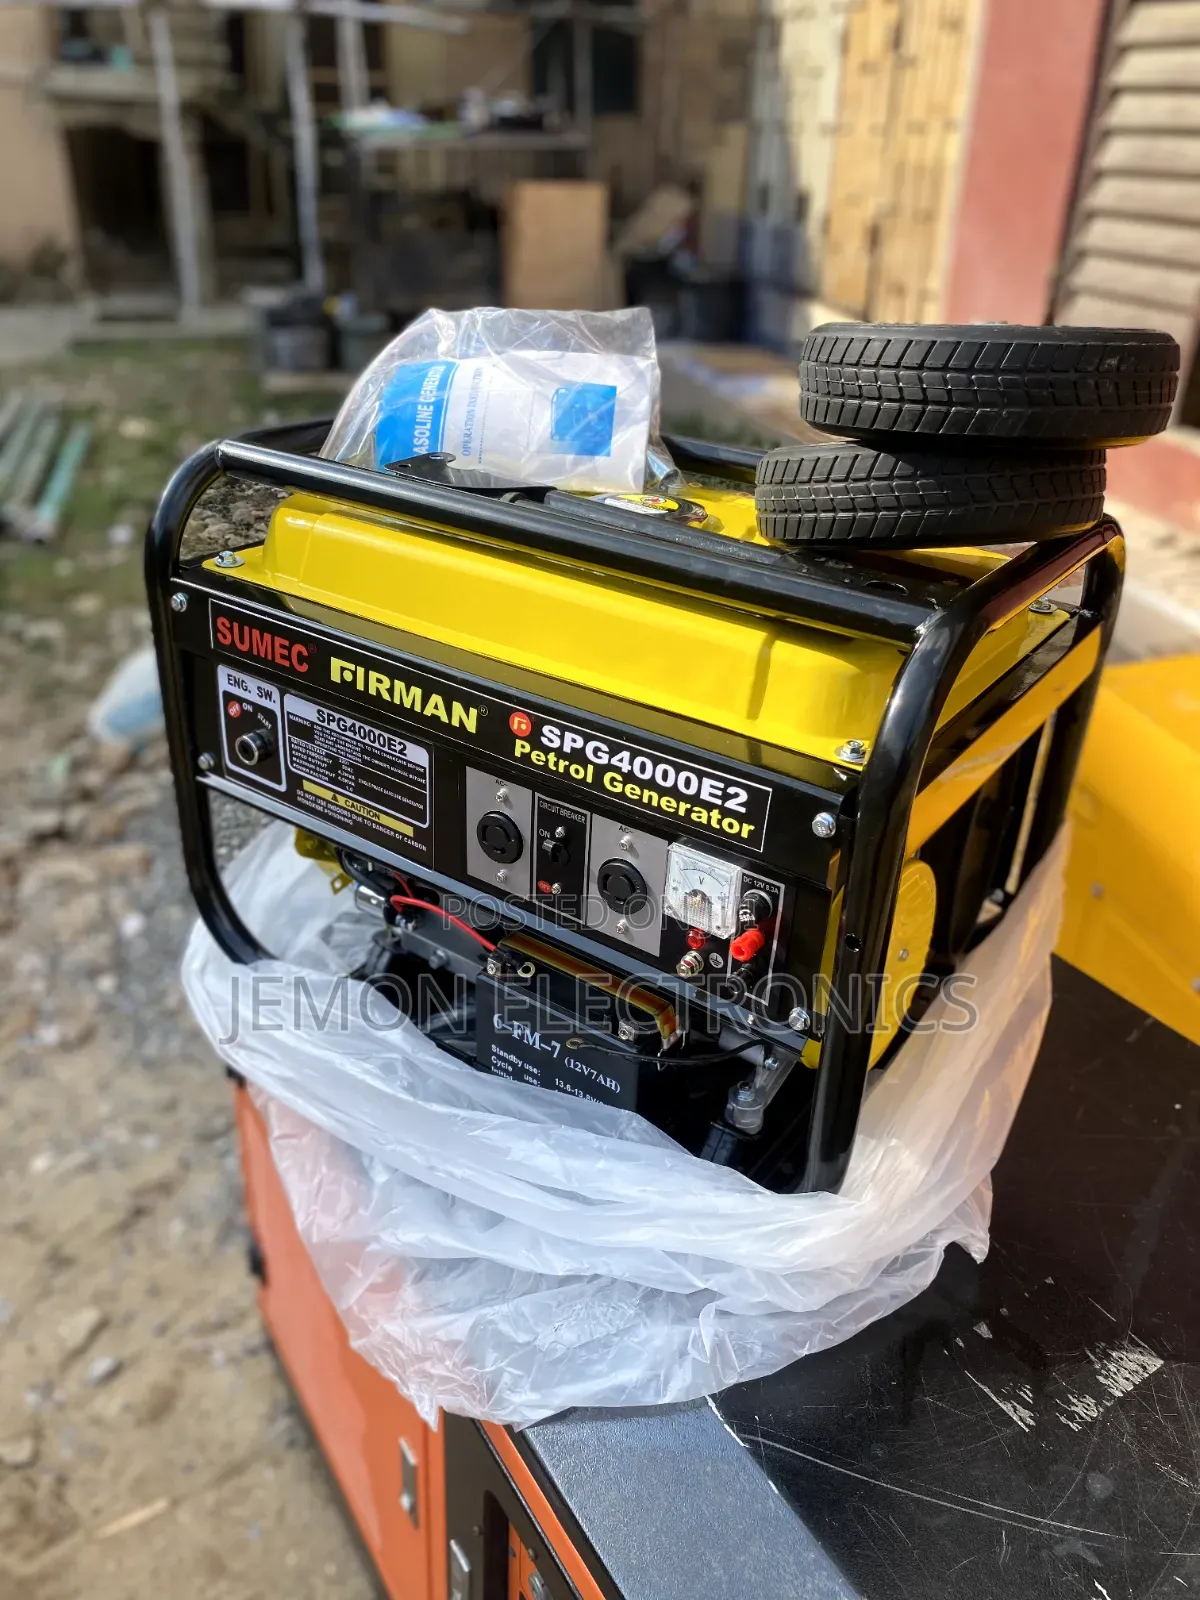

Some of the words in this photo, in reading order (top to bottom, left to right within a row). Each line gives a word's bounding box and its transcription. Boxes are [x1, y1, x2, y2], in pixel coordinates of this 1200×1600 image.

[413, 404, 434, 454] ASOLINE
[462, 409, 475, 457] OPERATION
[217, 617, 309, 672] SUMEC
[227, 673, 251, 694] ENG.
[257, 685, 276, 703] SW.
[330, 656, 478, 734] FIRMAN
[229, 703, 240, 716] OFF
[242, 702, 253, 712] ON
[257, 712, 272, 729] START
[317, 708, 408, 757] SPG4000E2
[540, 724, 749, 813] SPG4000E2
[514, 738, 593, 784] Petrol
[603, 772, 755, 839] Generator
[344, 800, 380, 820] CAUTION
[539, 801, 560, 814] CIRCUIT
[560, 808, 586, 825] BREAKER
[364, 818, 371, 826] TO
[403, 836, 426, 851] CARBON
[539, 828, 551, 838] ON
[539, 882, 551, 891] OFF
[698, 876, 704, 885] V
[743, 876, 752, 885] DC
[753, 879, 765, 889] 12V
[765, 885, 779, 895] 8.3A
[493, 1013, 561, 1058] 6-FM-7
[491, 1044, 523, 1068] Standby
[524, 1059, 541, 1076] use:
[491, 1055, 513, 1072] Cycle
[524, 1073, 541, 1087] use:
[565, 1056, 621, 1093] (12V7AH)
